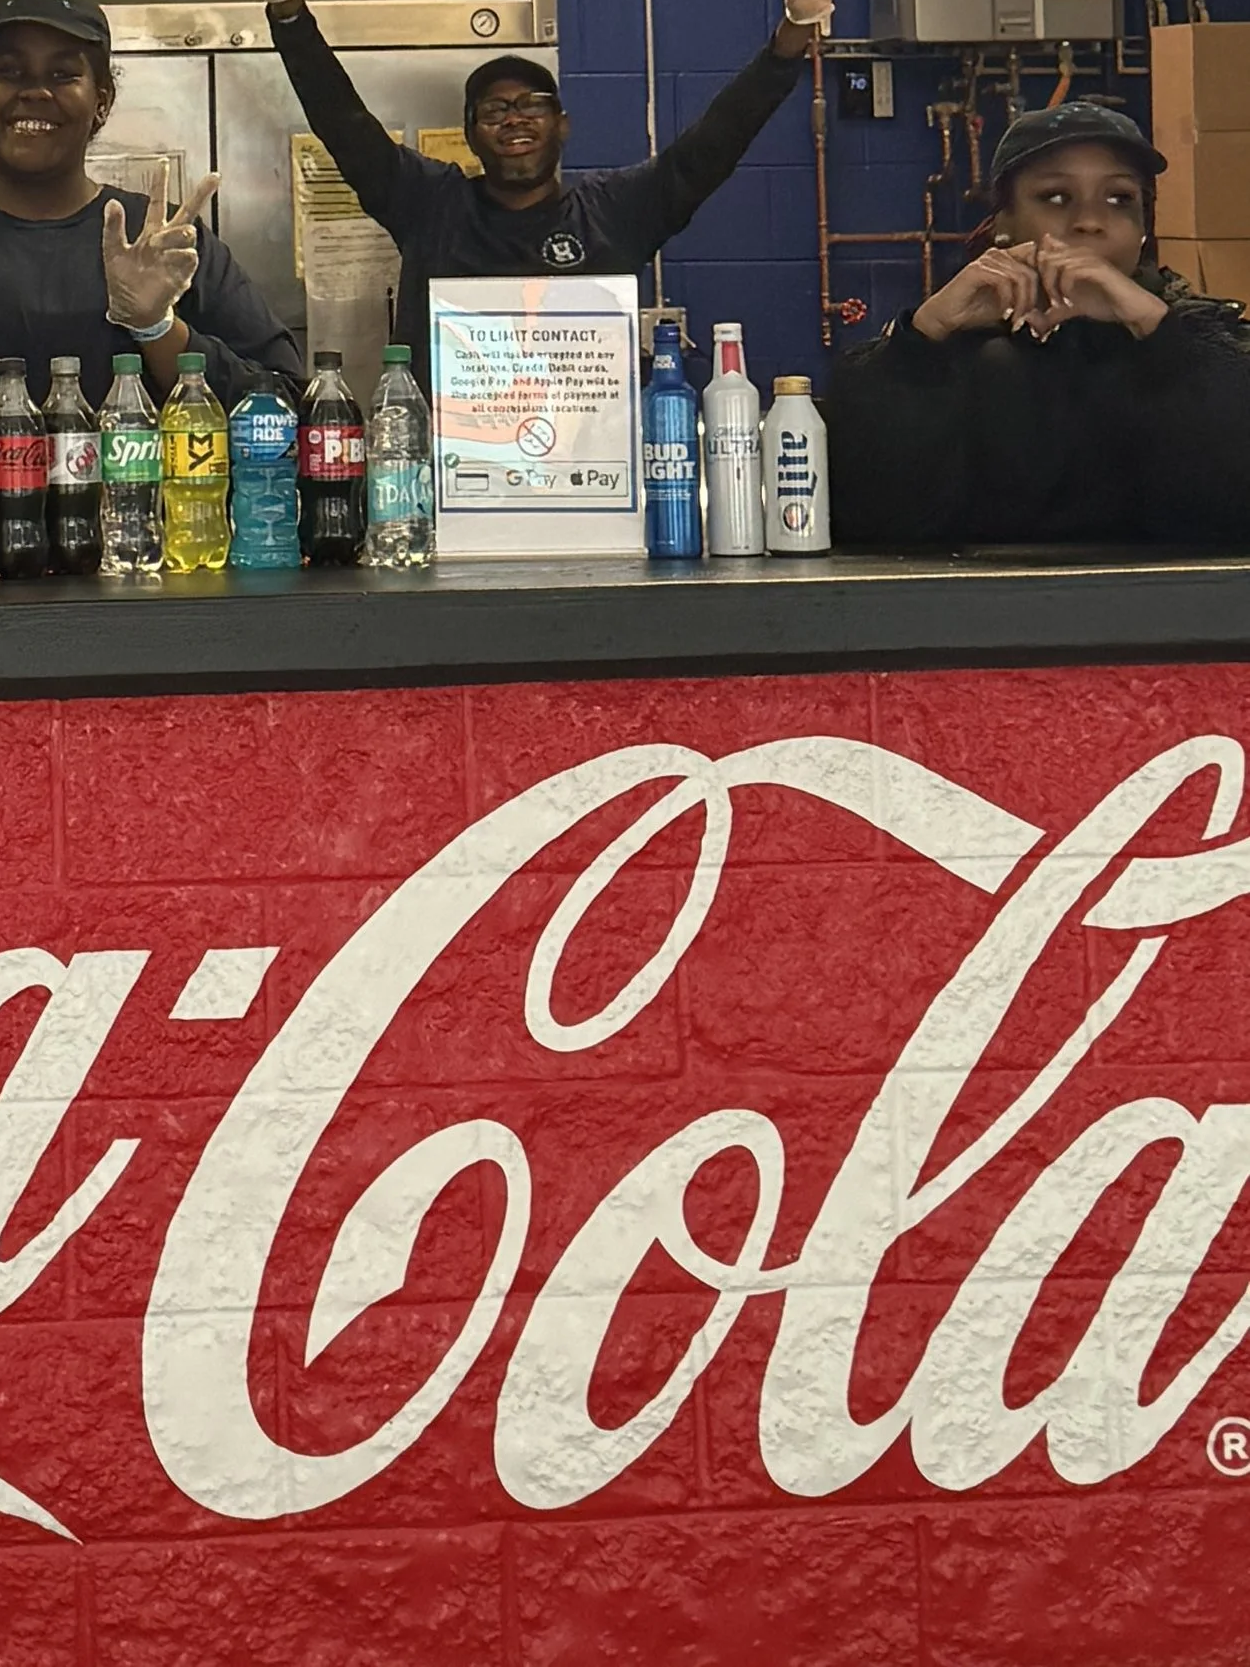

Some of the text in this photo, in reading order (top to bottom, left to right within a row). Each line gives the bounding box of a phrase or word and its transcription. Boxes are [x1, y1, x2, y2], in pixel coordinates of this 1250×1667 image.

[470, 329, 602, 344] TO LIMIT CONTACT,
[565, 377, 583, 388] Pay
[643, 443, 688, 461] BUD
[643, 461, 696, 480] IGHT
[777, 431, 818, 499] Lite
[587, 469, 619, 490] Pay
